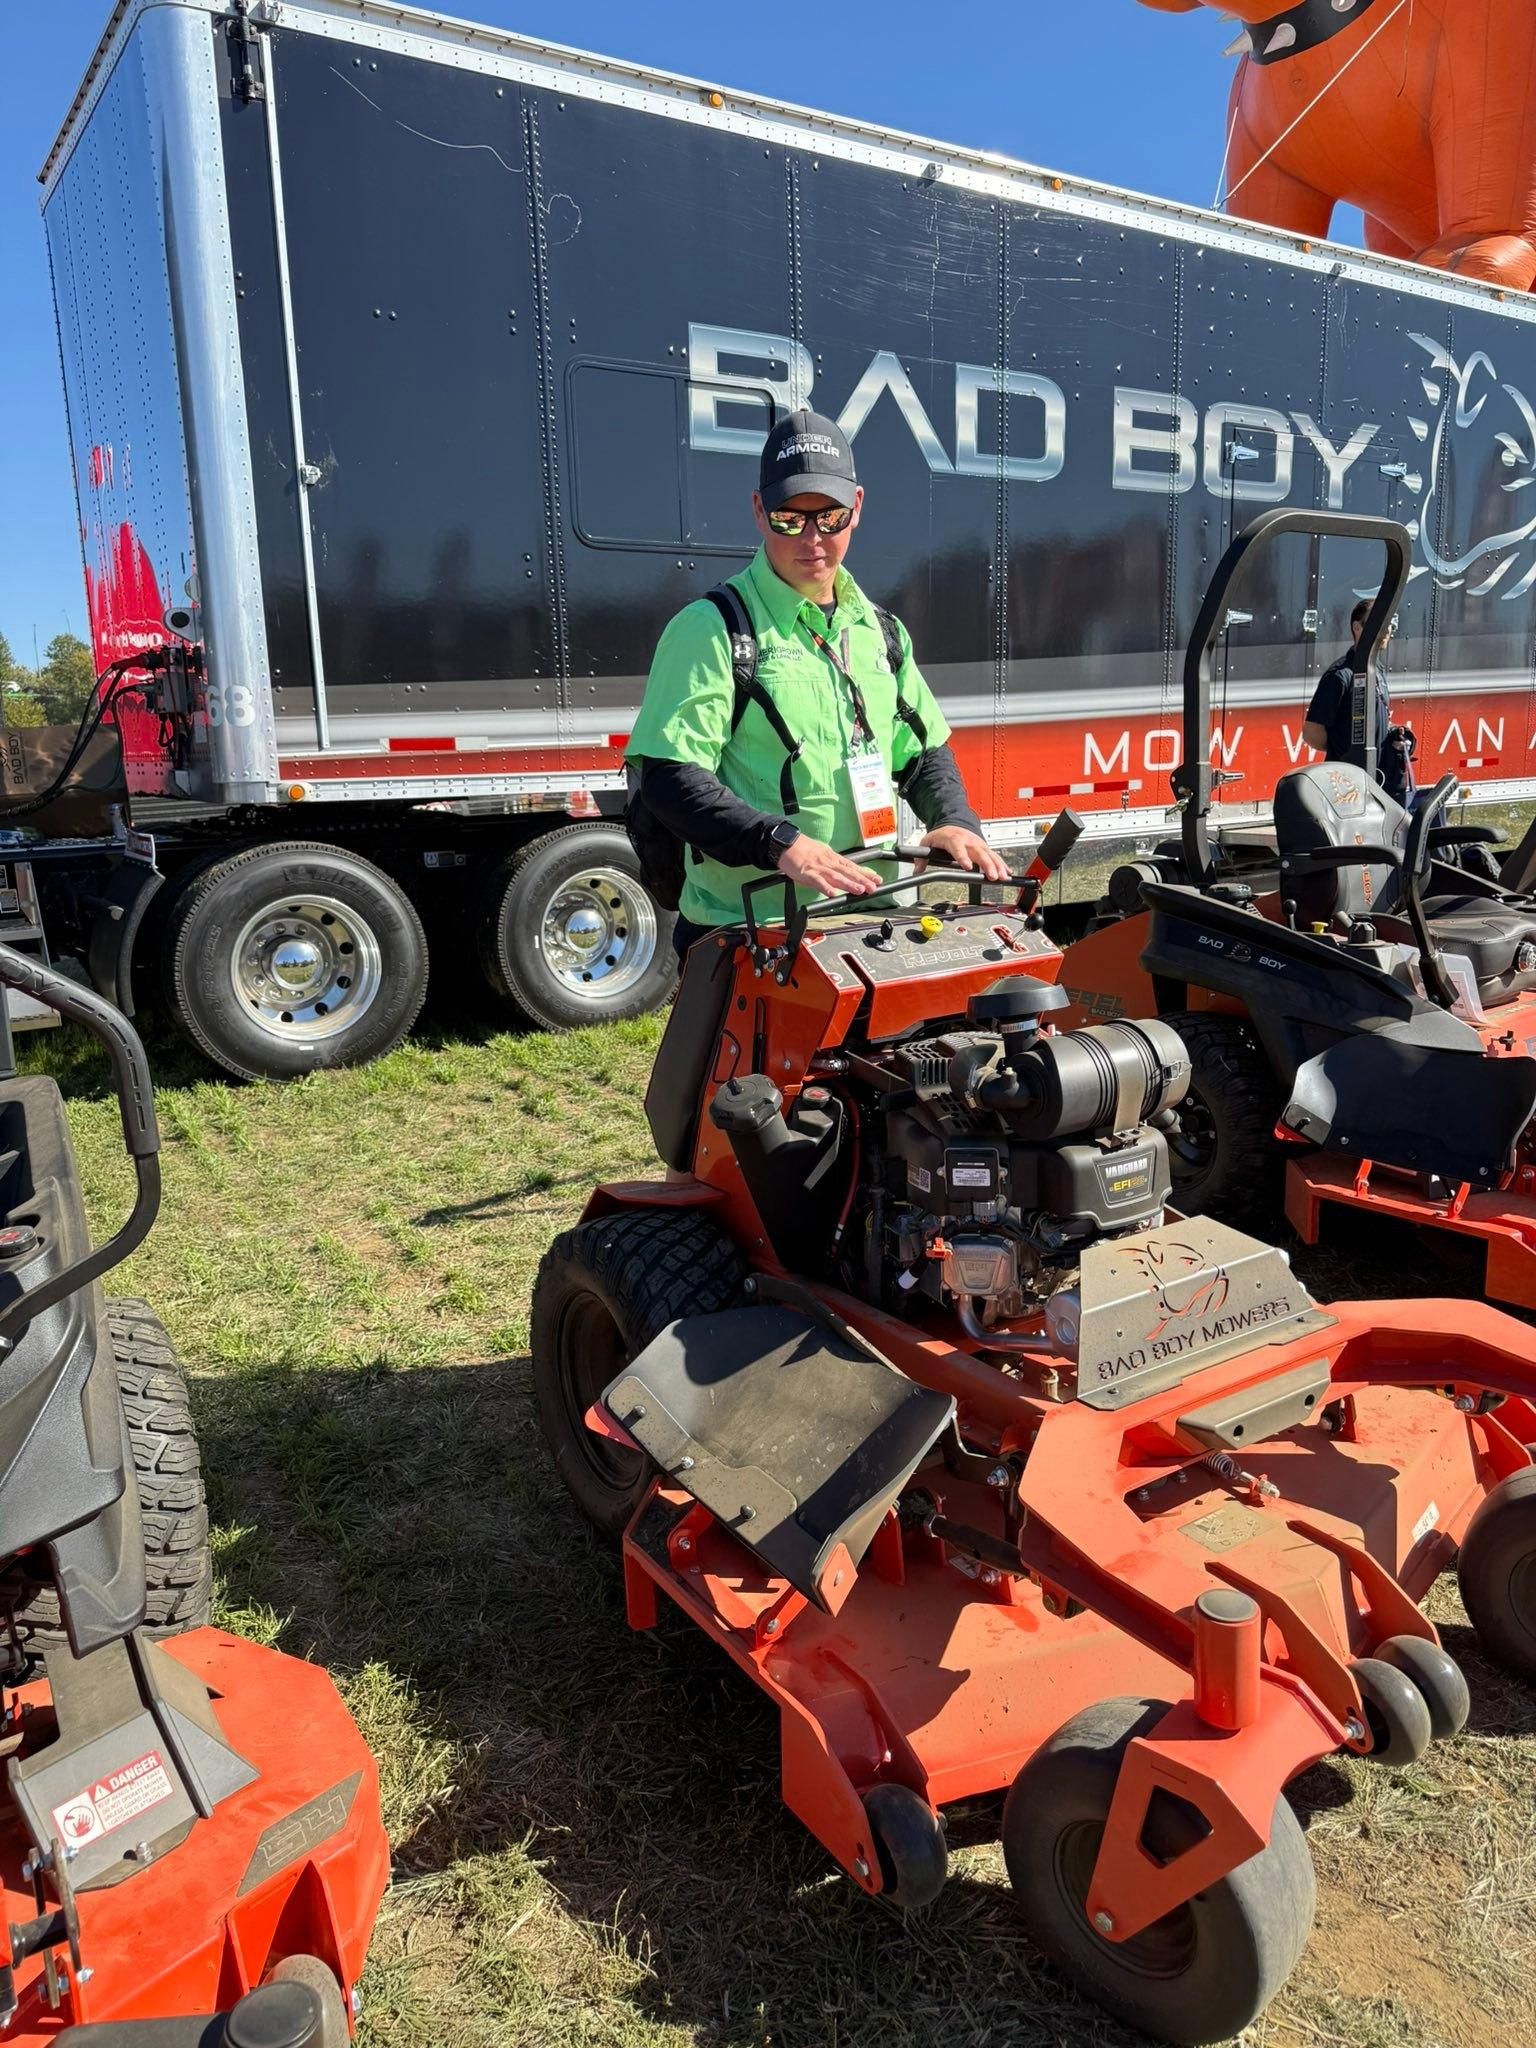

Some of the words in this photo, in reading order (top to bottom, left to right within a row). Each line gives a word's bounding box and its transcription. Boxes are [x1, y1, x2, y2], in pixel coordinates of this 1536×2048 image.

[688, 321, 1066, 482] BAD
[1112, 385, 1382, 509] BOY
[776, 443, 840, 461] ARMOUR
[781, 432, 832, 449] UNDER
[1083, 725, 1244, 776] MOW
[901, 945, 985, 968] REVOLT
[1198, 935, 1224, 949] BAD
[1259, 956, 1287, 970] BOY
[1098, 1350, 1146, 1380] BAD
[1152, 1330, 1195, 1361] BOY
[1202, 1297, 1290, 1342] MOWERS
[108, 1756, 159, 1790] DANGER
